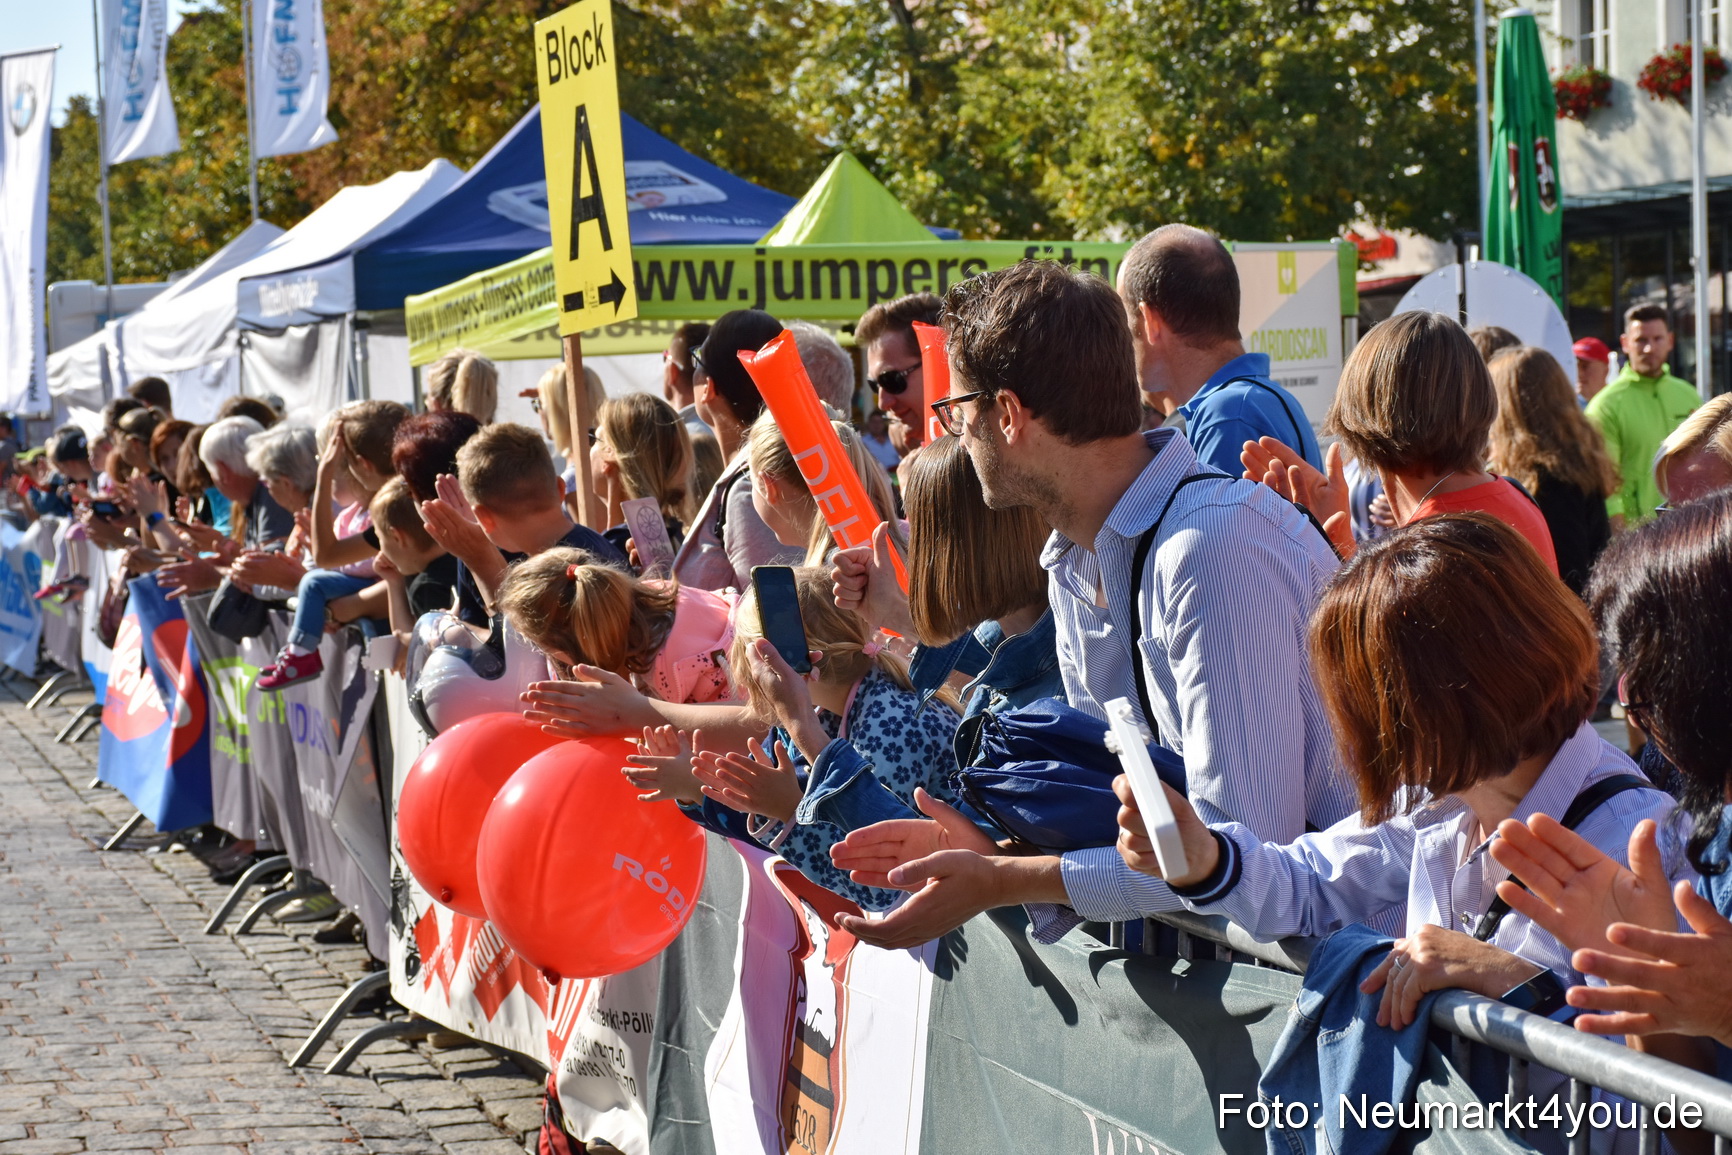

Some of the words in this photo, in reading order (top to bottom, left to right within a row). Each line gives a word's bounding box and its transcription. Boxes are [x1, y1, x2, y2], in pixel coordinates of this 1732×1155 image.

[546, 11, 607, 85] Block
[569, 103, 614, 262] A
[1250, 327, 1328, 362] CARDIOSCAN
[467, 920, 505, 985] raun
[790, 1103, 817, 1155] 1628
